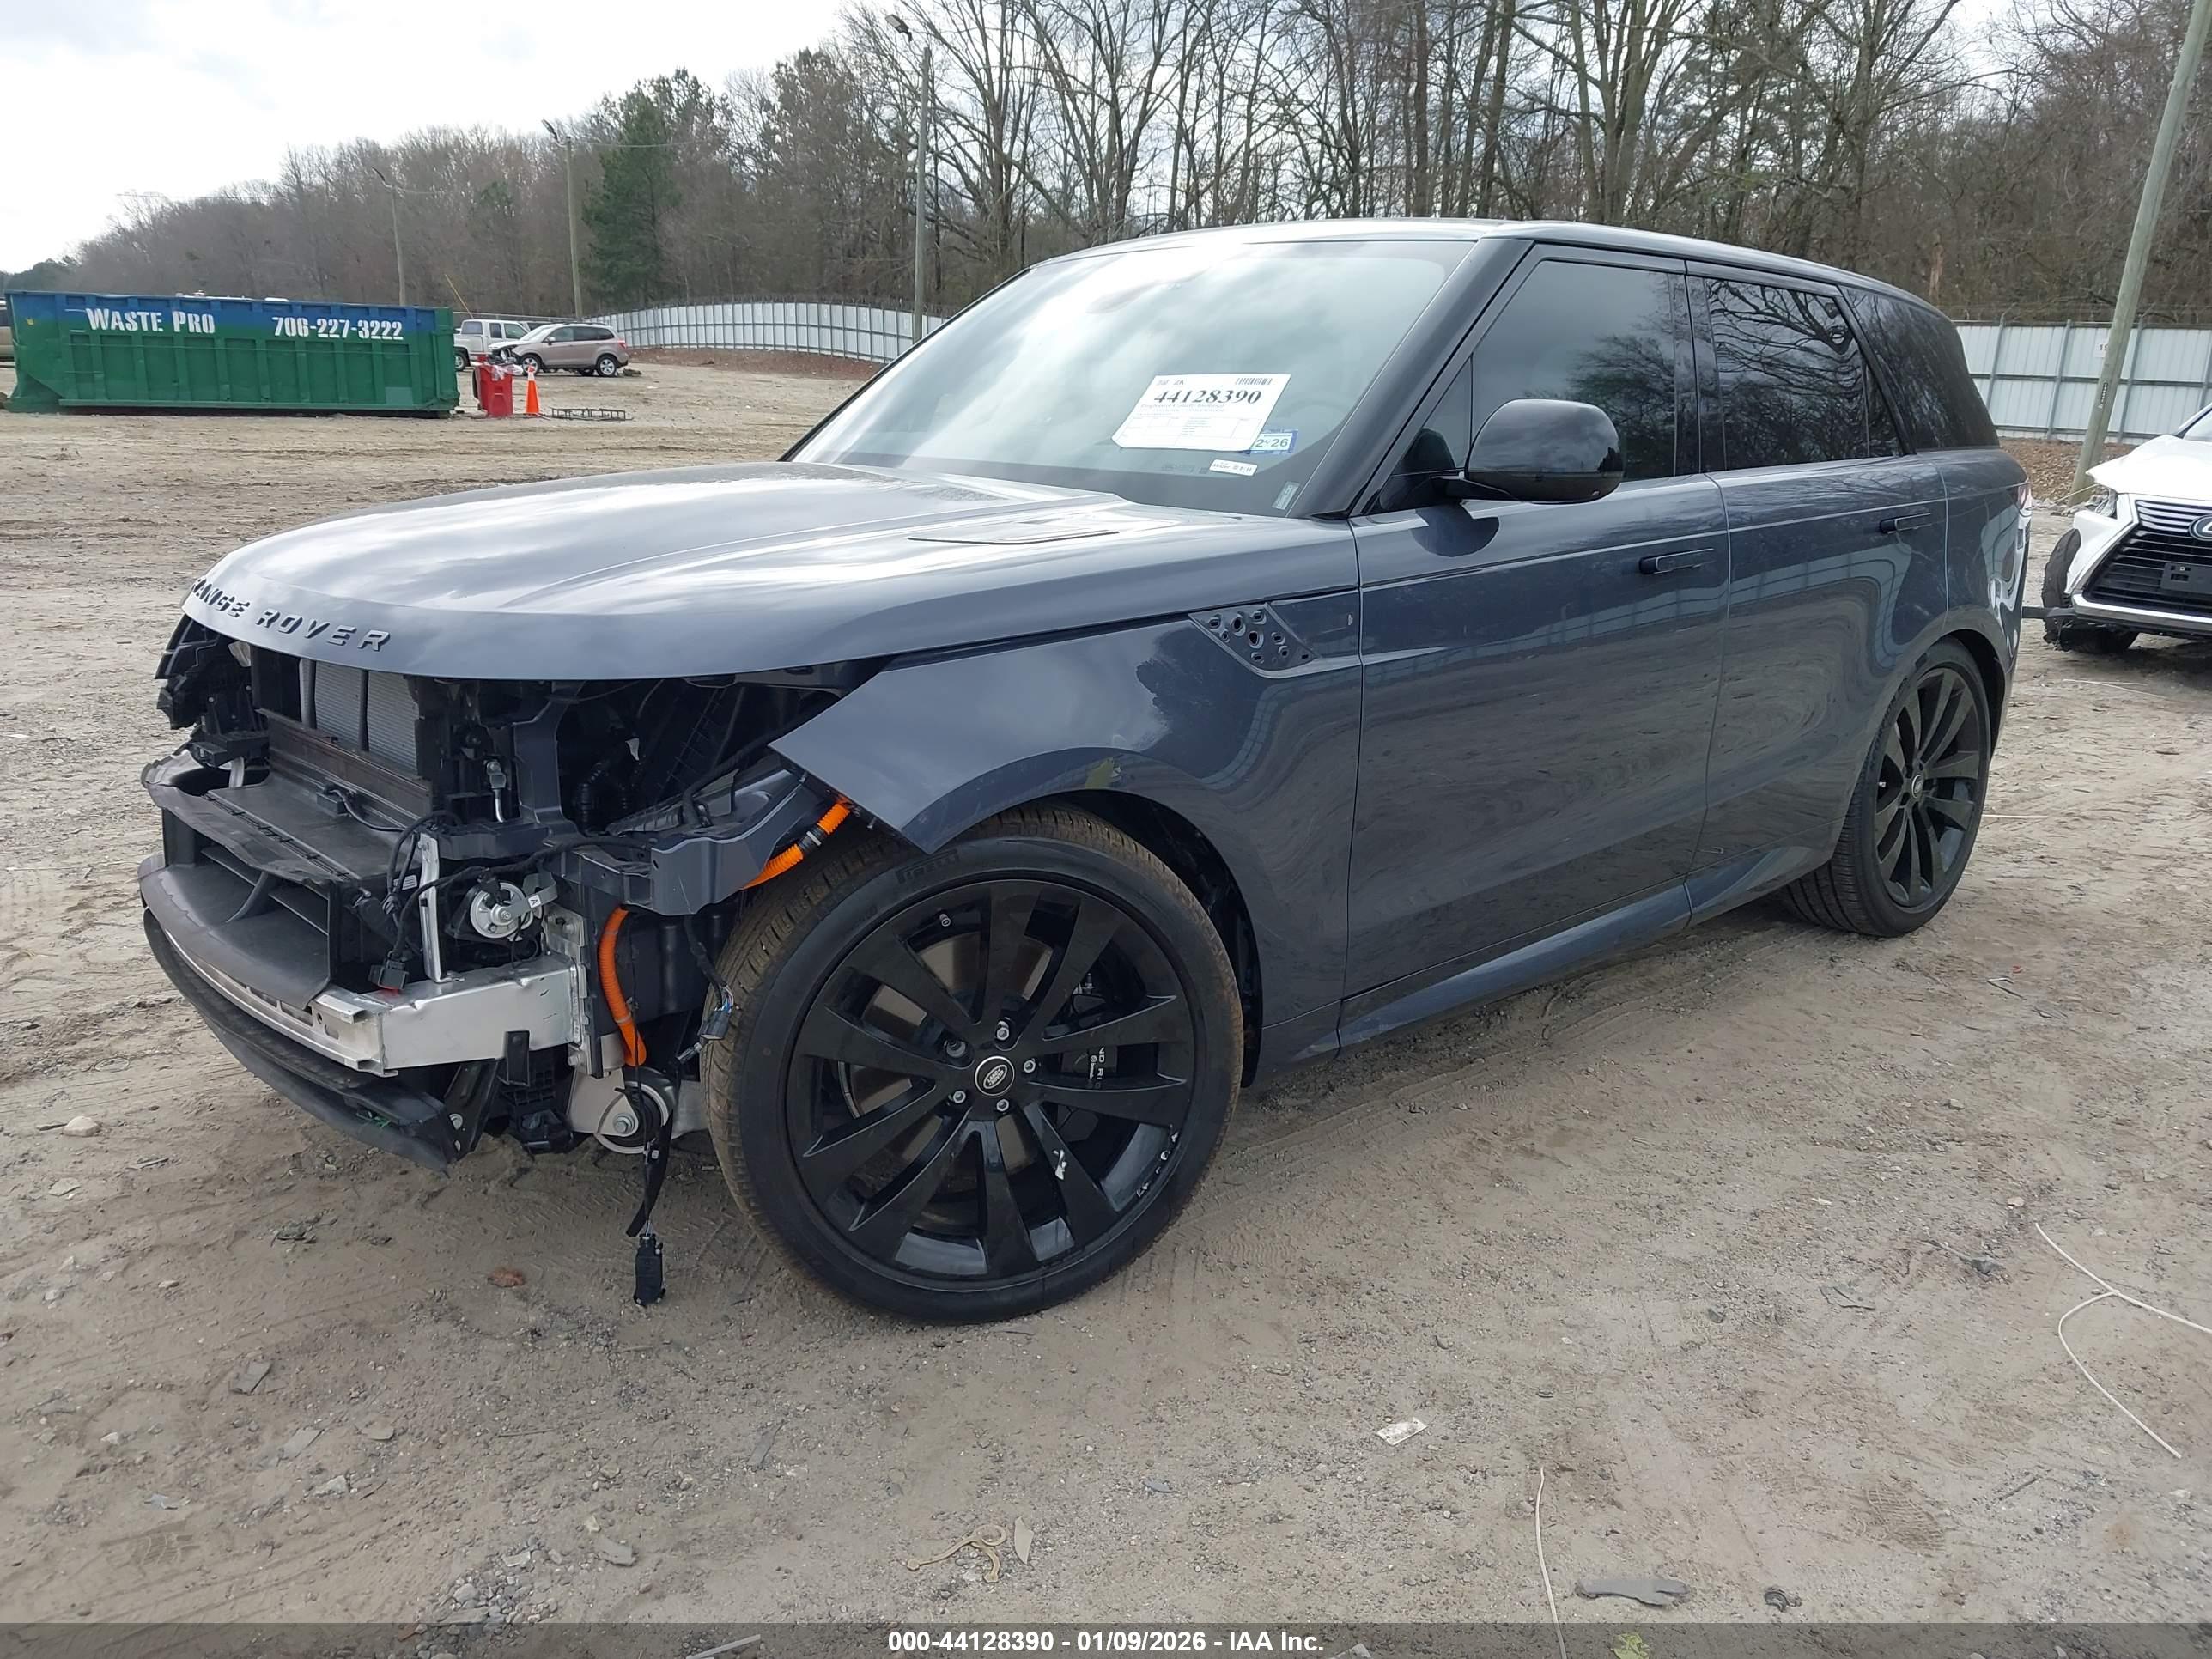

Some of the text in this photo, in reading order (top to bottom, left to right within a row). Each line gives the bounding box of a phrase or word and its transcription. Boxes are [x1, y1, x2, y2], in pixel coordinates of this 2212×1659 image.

[85, 307, 216, 333] WASTE PRO
[271, 317, 404, 340] 706-227-3222
[1154, 390, 1261, 404] 44128390
[256, 608, 391, 652] ROVER
